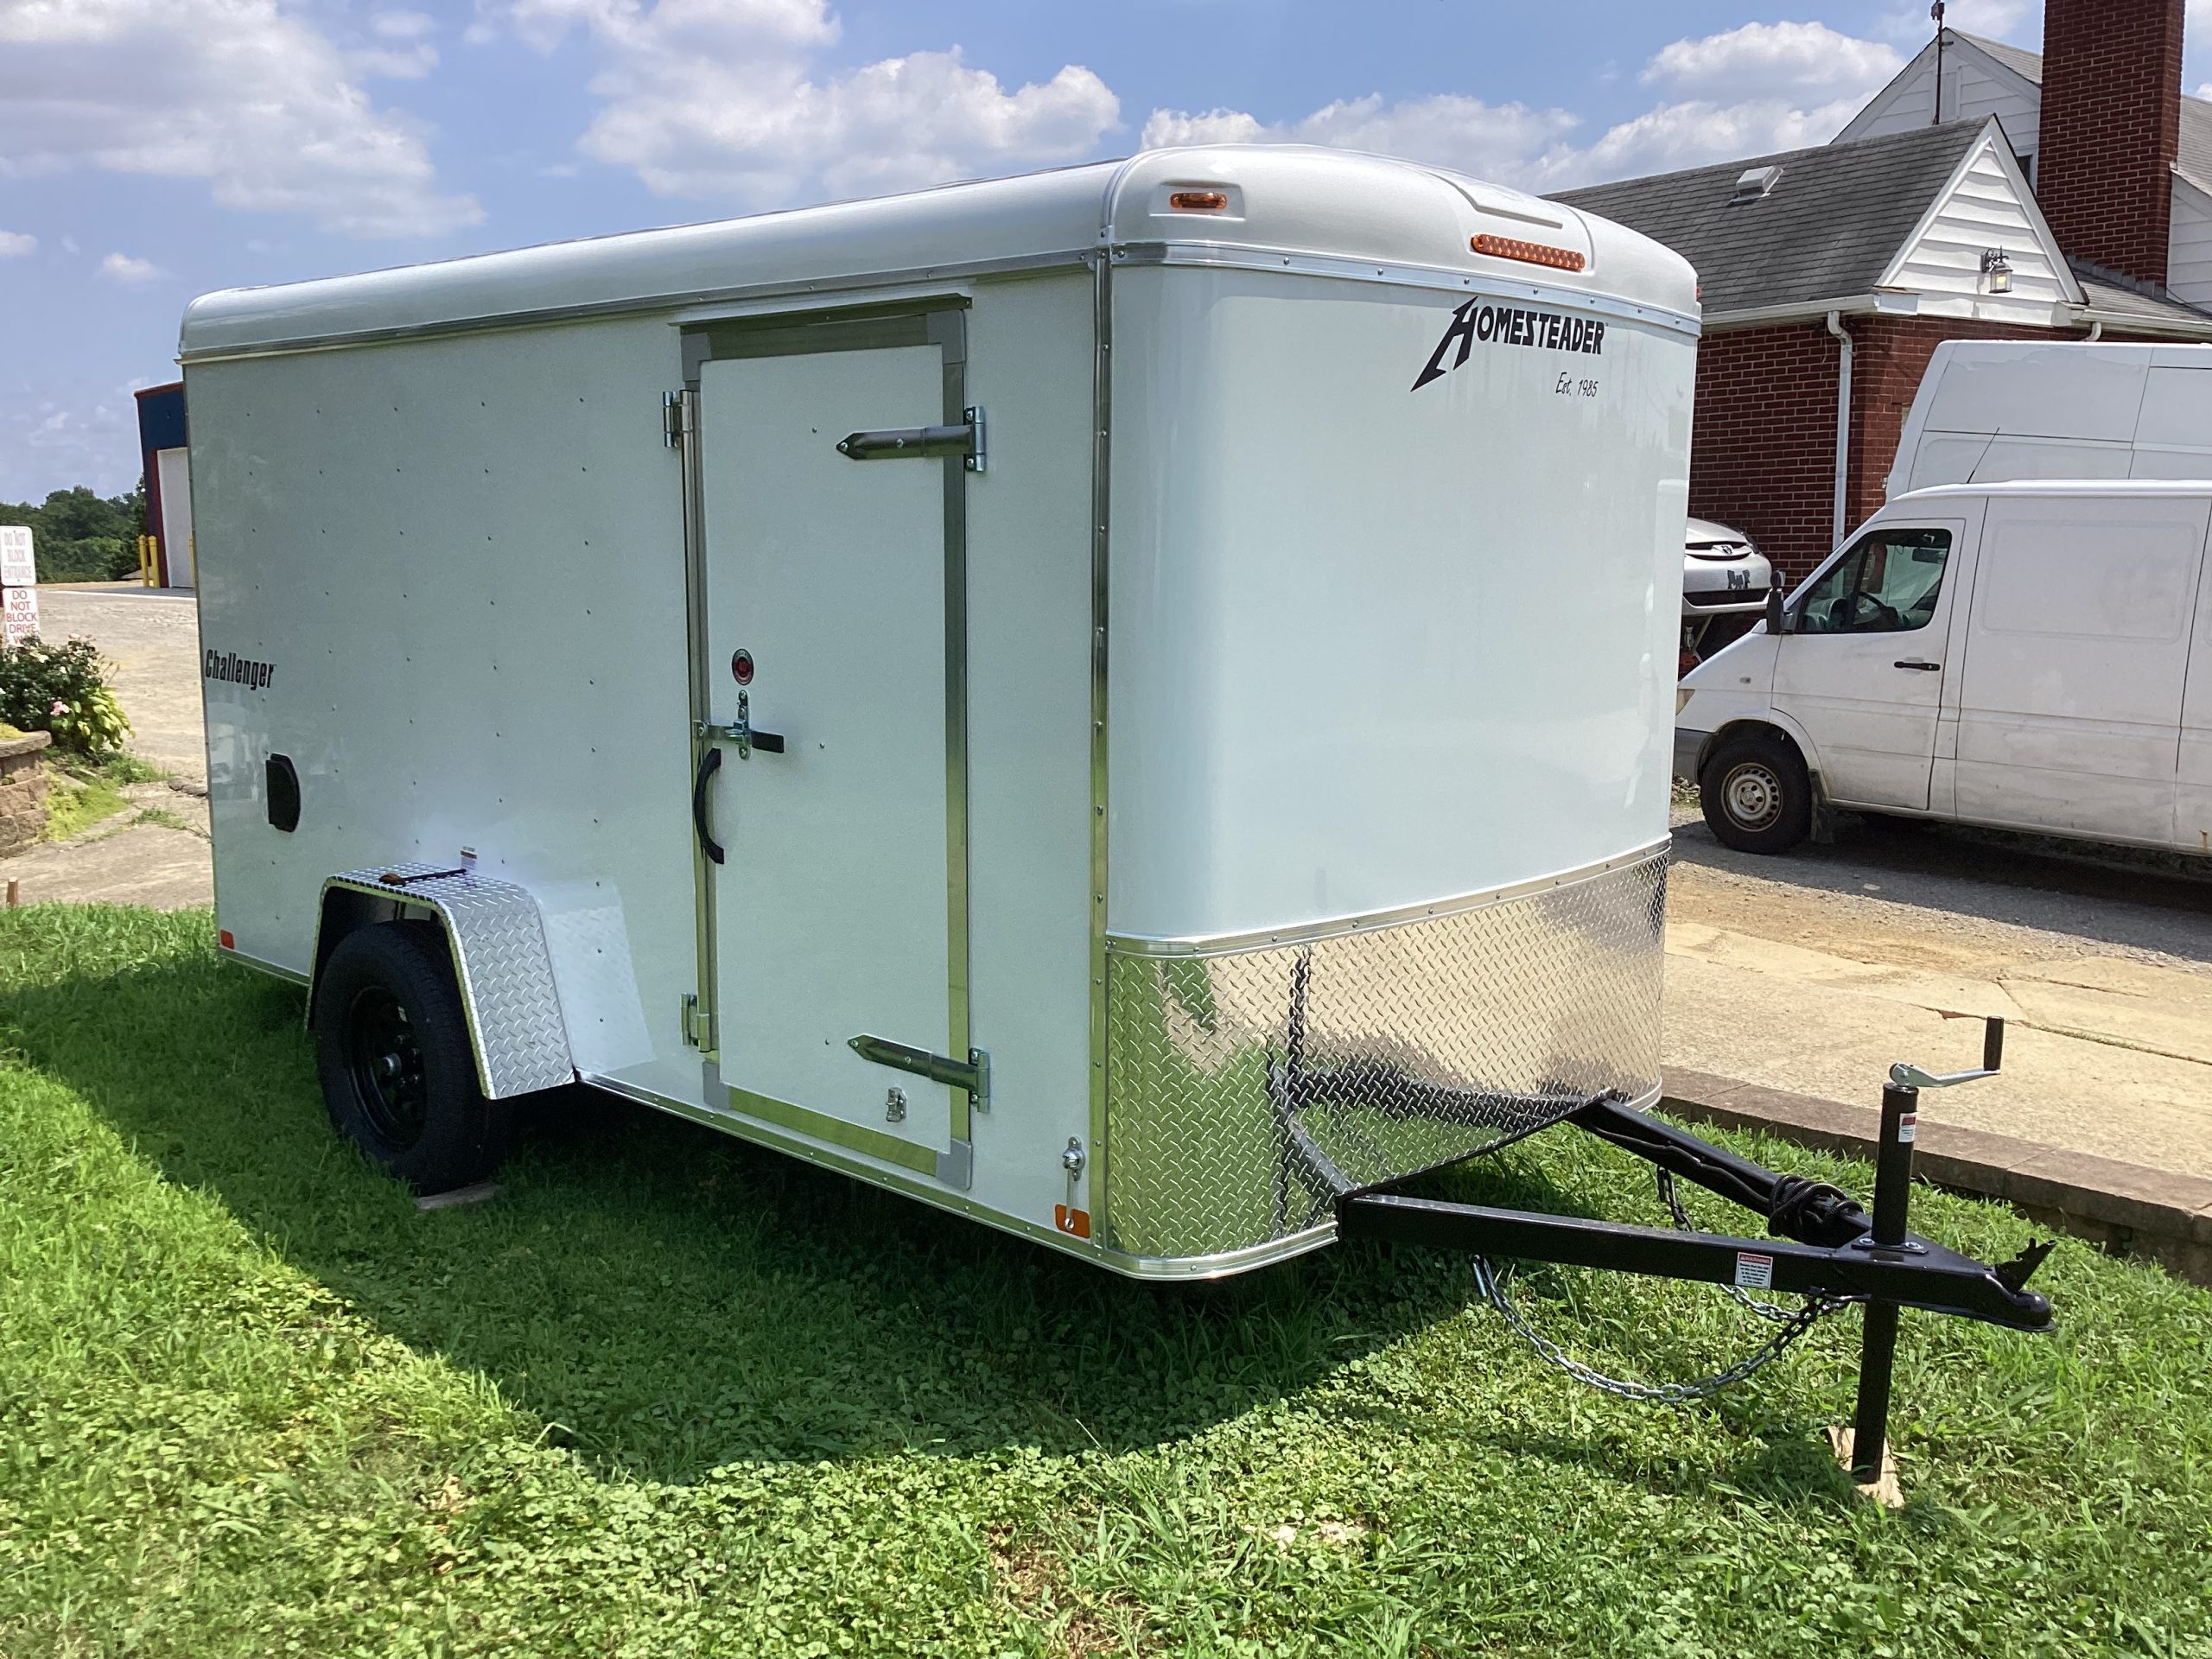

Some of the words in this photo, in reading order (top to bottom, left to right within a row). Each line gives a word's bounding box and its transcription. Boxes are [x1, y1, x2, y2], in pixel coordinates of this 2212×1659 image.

[1410, 296, 1605, 392] HOMESTEADER
[1556, 372, 1572, 396] Est.
[1577, 379, 1599, 397] 1985
[4, 532, 12, 546] DO
[15, 532, 25, 546] NOT
[7, 549, 26, 562] BLOCK
[4, 565, 32, 578] ENTRANCE
[12, 590, 27, 600] DO
[10, 601, 30, 611] NOT
[6, 613, 38, 622] BLOCK
[205, 649, 275, 691] Challenger
